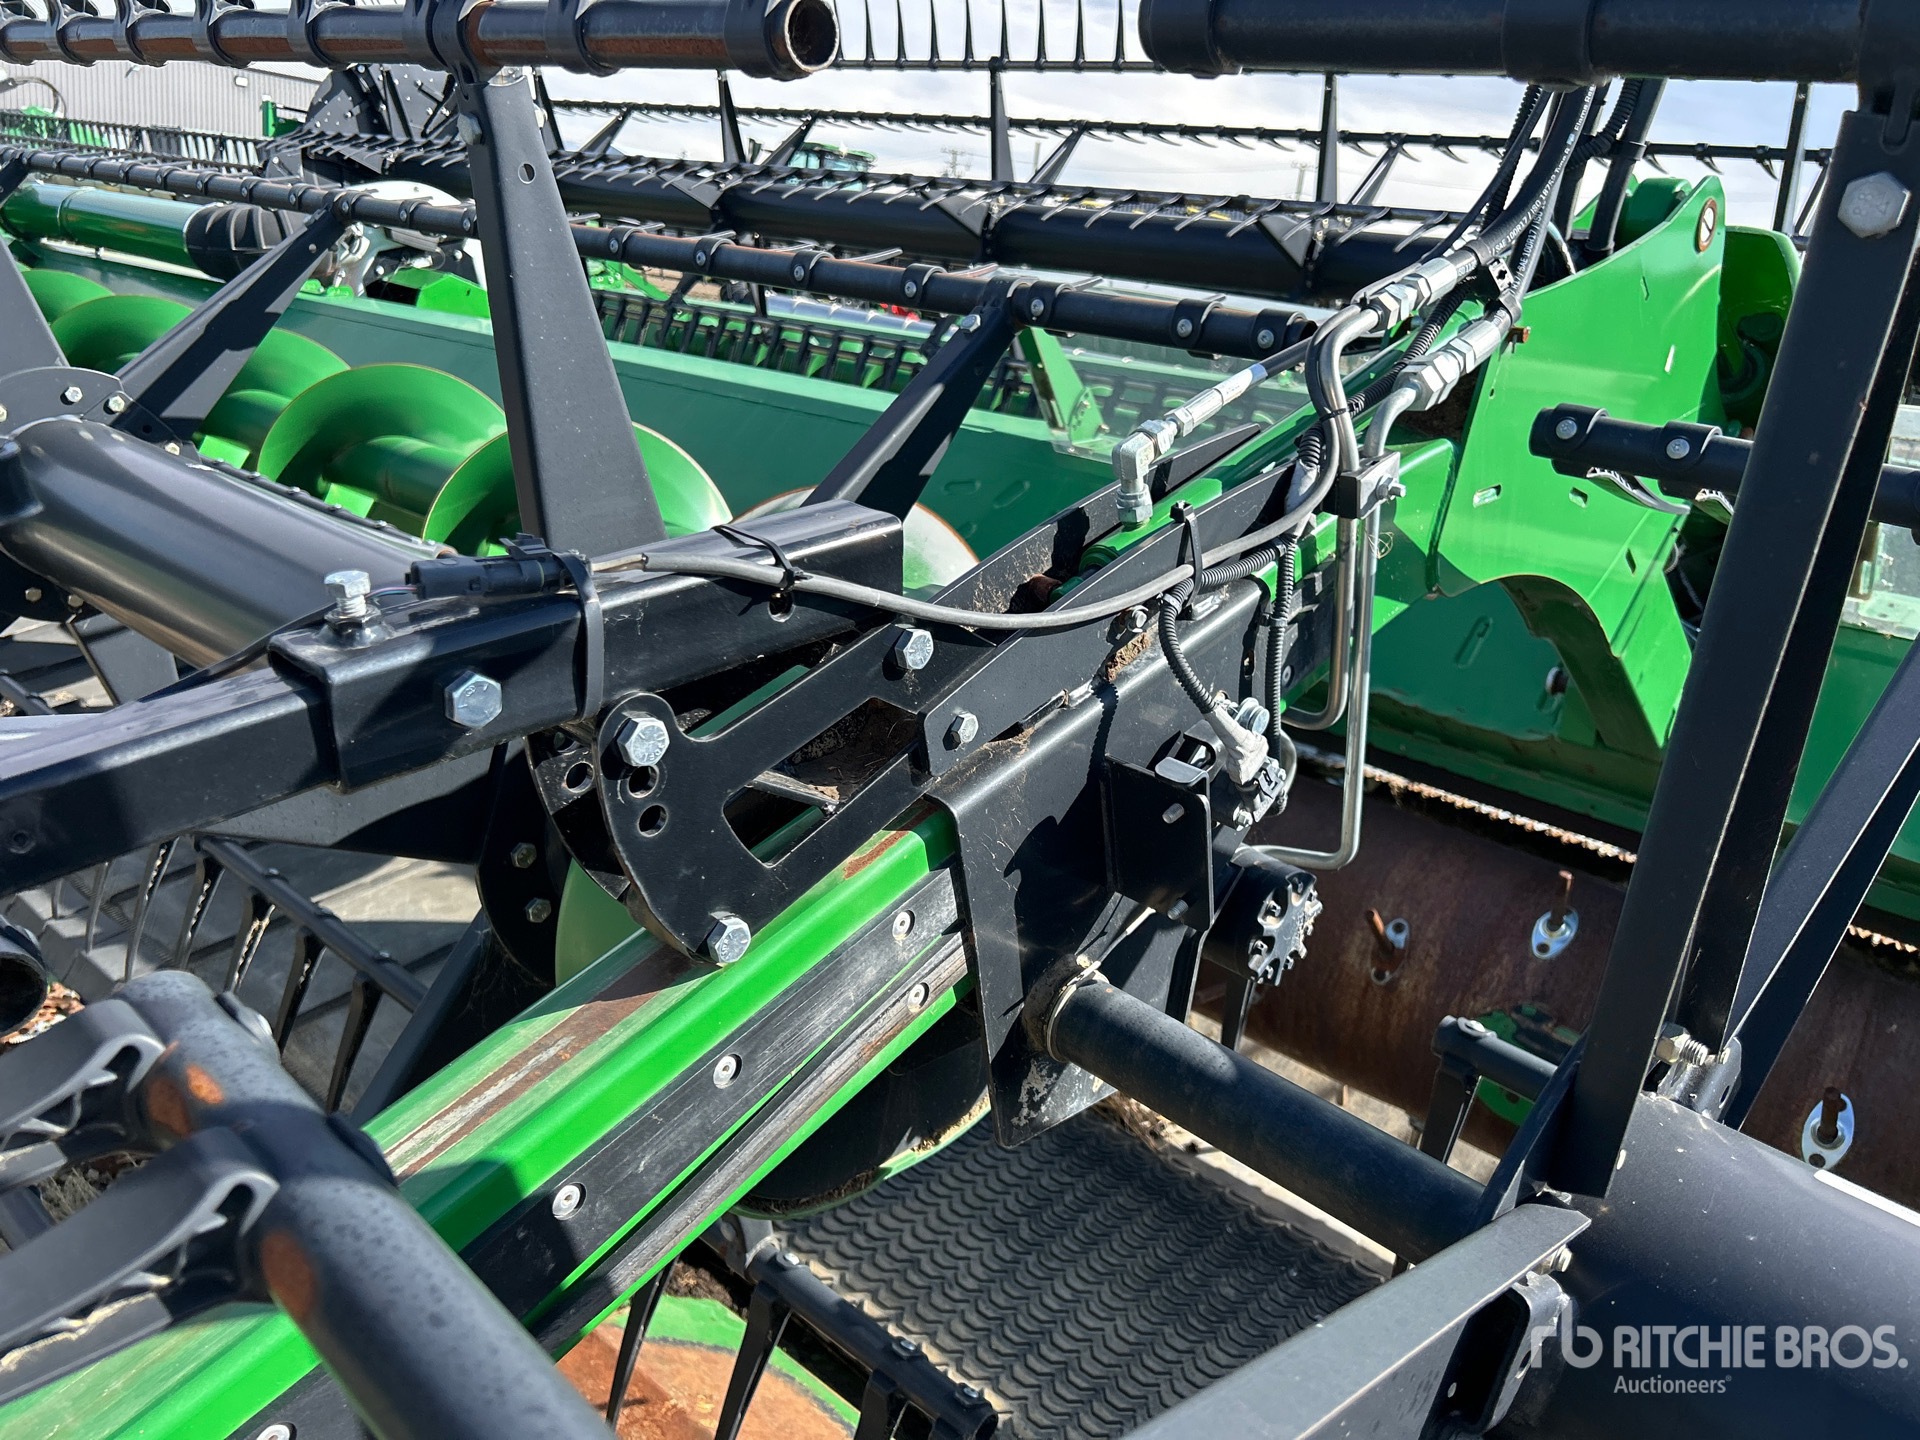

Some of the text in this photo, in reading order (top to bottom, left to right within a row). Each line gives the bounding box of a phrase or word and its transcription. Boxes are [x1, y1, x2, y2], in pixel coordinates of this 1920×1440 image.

[1495, 239, 1506, 253] SAE
[1506, 216, 1528, 243] 100R17
[1530, 199, 1542, 214] ISO
[1574, 104, 1589, 131] Flame
[1522, 229, 1538, 257] 100R17
[1517, 257, 1529, 271] SAE
